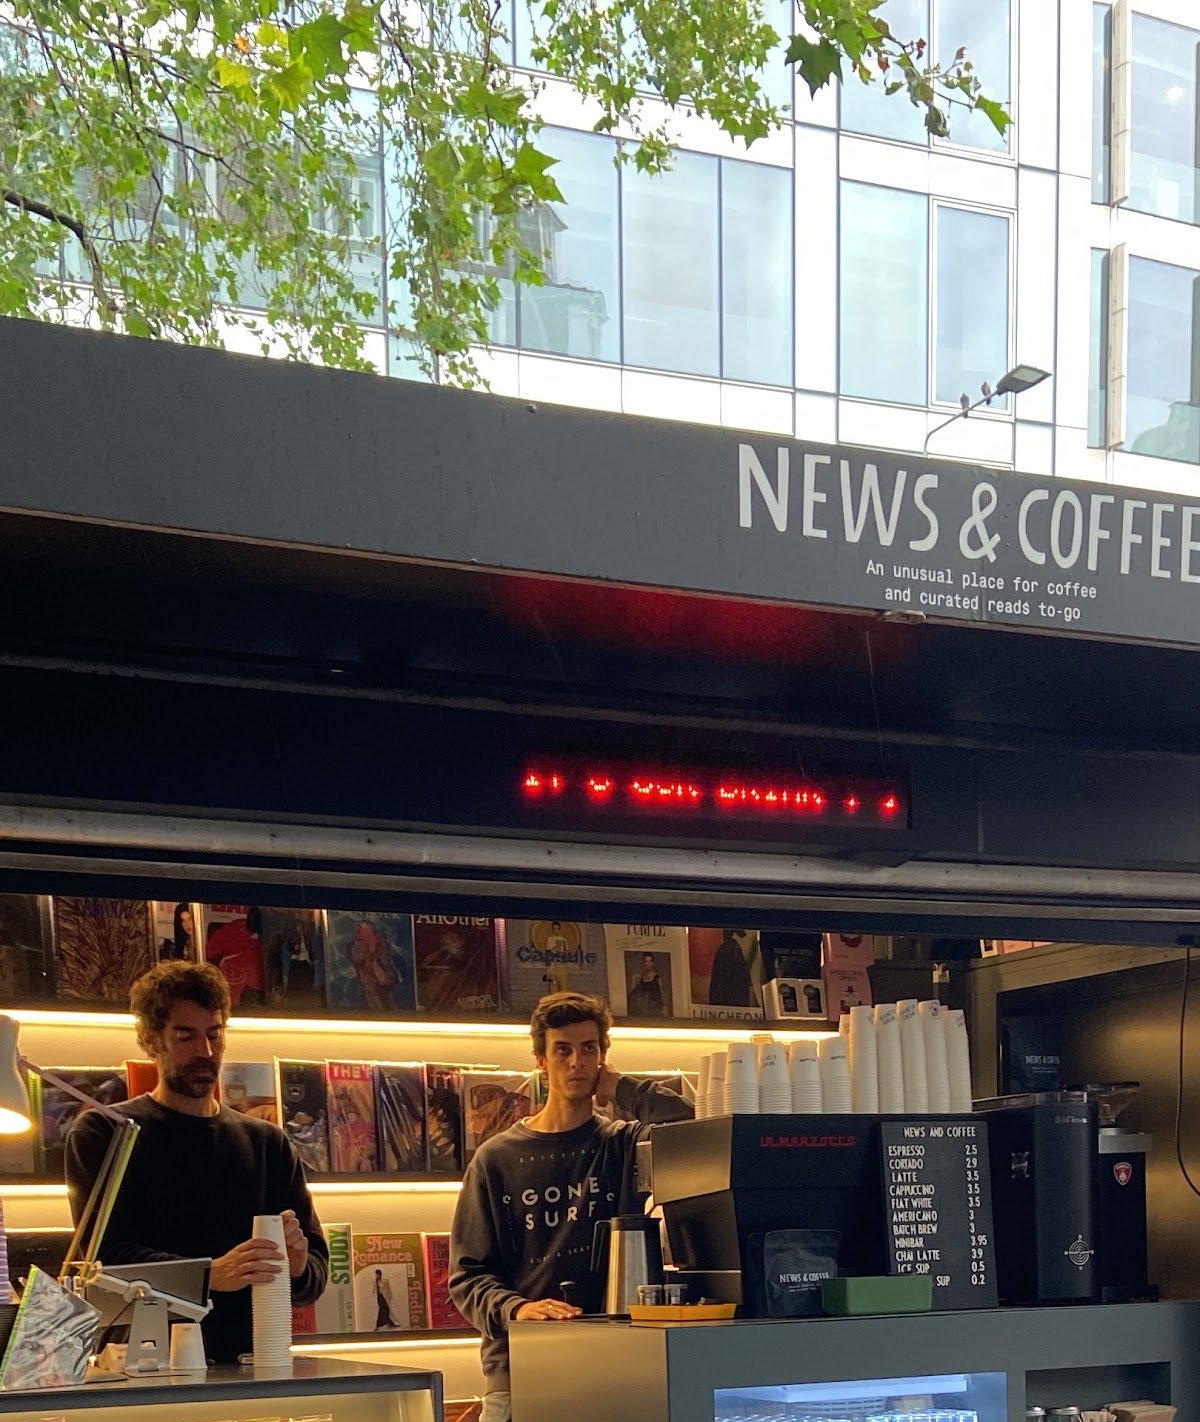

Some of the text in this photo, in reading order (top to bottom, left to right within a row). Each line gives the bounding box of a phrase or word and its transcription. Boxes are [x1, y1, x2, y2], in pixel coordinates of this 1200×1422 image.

[738, 443, 1200, 584] NEWS & COFFEE
[866, 559, 1098, 600] An unusual place for coffee
[884, 585, 1082, 623] and curated reads to-go
[333, 1065, 361, 1079] THE
[904, 1127, 976, 1138] NEWS AND COFFEE
[888, 1145, 978, 1157] ESPRESSO 2.5
[889, 1158, 978, 1170] CORTADO 2.9
[892, 1171, 979, 1183] LATTE 3.5
[521, 1176, 600, 1206] GONE
[889, 1184, 980, 1196] CAPPUCCINO 3.5
[892, 1197, 980, 1209] FLAT WHITE 3.5
[525, 1200, 597, 1231] SURF
[892, 1210, 974, 1222] AMERICANO 3
[893, 1223, 975, 1236] BATCH BREW 3
[366, 1235, 404, 1251] New
[895, 1235, 987, 1249] MINIBAR 3.95
[329, 1229, 349, 1285] STUDY
[353, 1249, 413, 1266] Romance
[896, 1248, 983, 1261] CHAI LATTE 3.9
[915, 1263, 930, 1274] SUP
[971, 1261, 985, 1272] 0.5
[779, 1273, 803, 1284] NEWS
[803, 1272, 808, 1282] &
[936, 1274, 985, 1287] SUP 0.2
[409, 1280, 423, 1324] Indie
